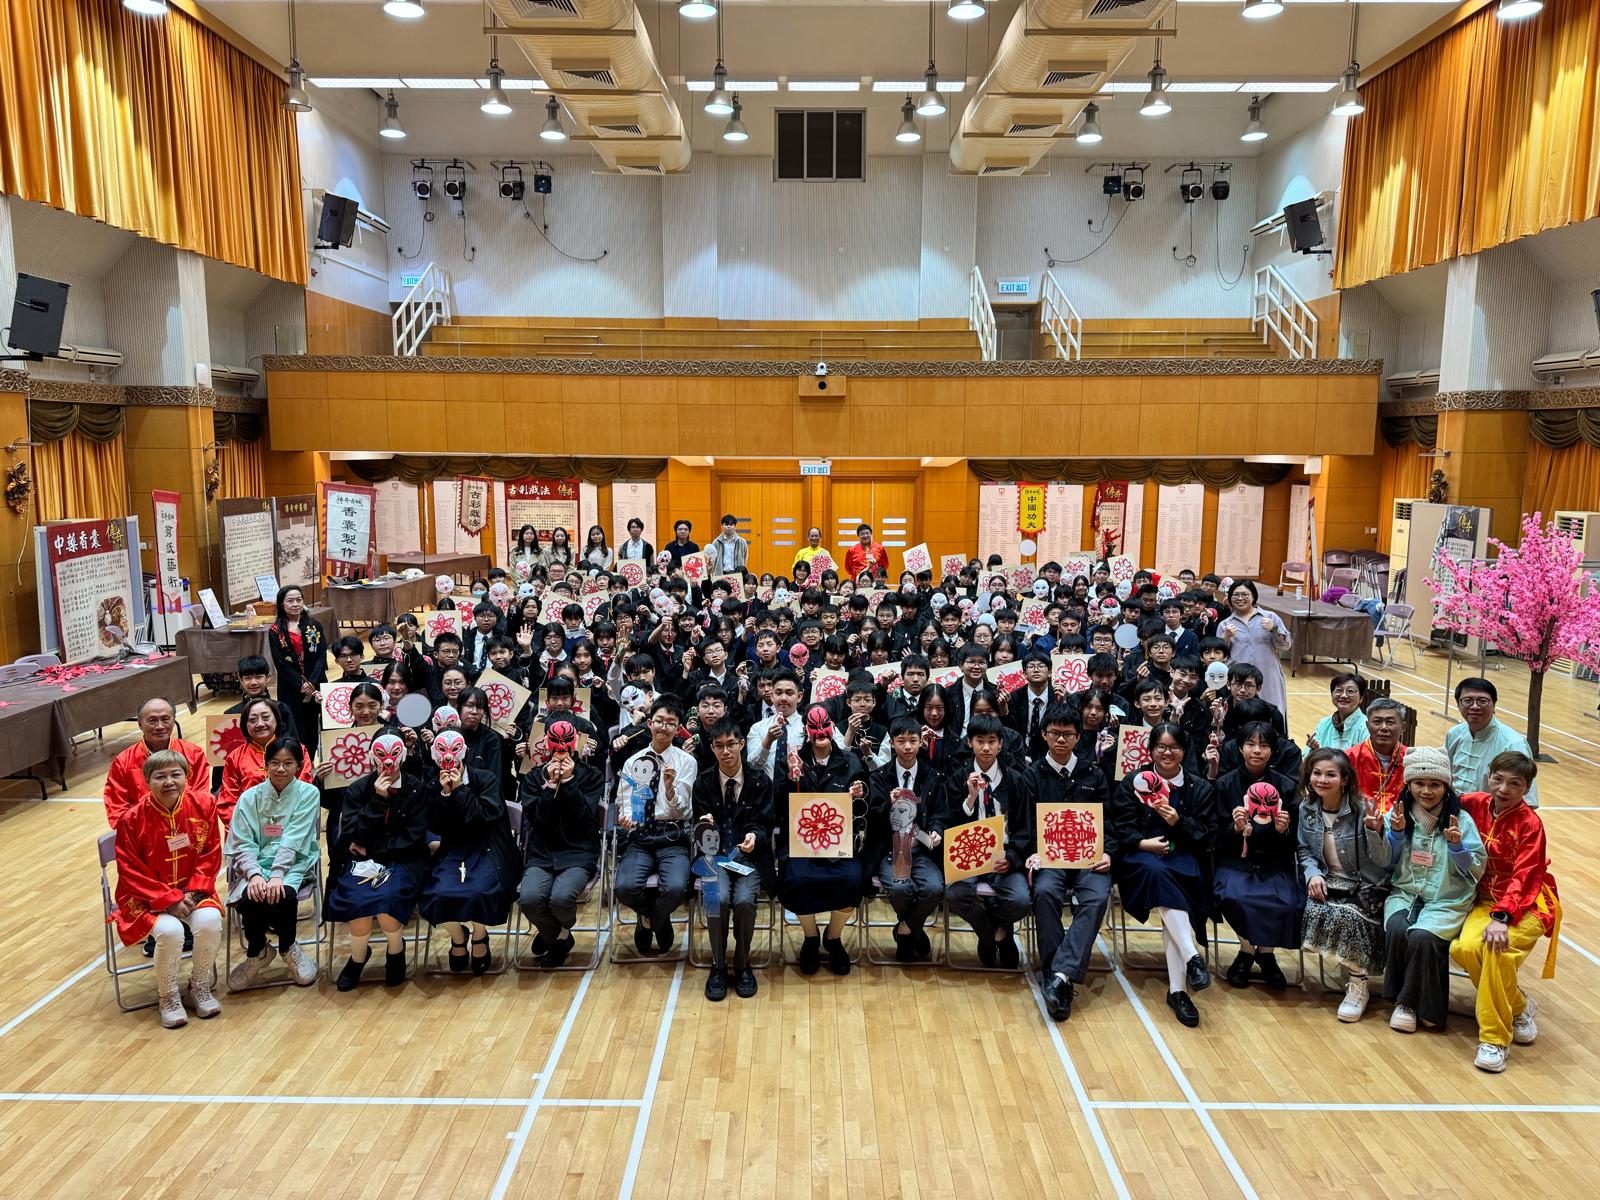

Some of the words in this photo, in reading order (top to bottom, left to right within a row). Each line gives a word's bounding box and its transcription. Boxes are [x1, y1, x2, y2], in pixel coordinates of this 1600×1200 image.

[1001, 283, 1015, 292] EXIT
[1016, 283, 1027, 292] 出口
[803, 466, 817, 474] EXIT
[817, 466, 828, 474] 出口
[1026, 495, 1037, 529] 中國功夫
[54, 528, 102, 556] 中藥香囊
[341, 506, 358, 559] 香囊製作
